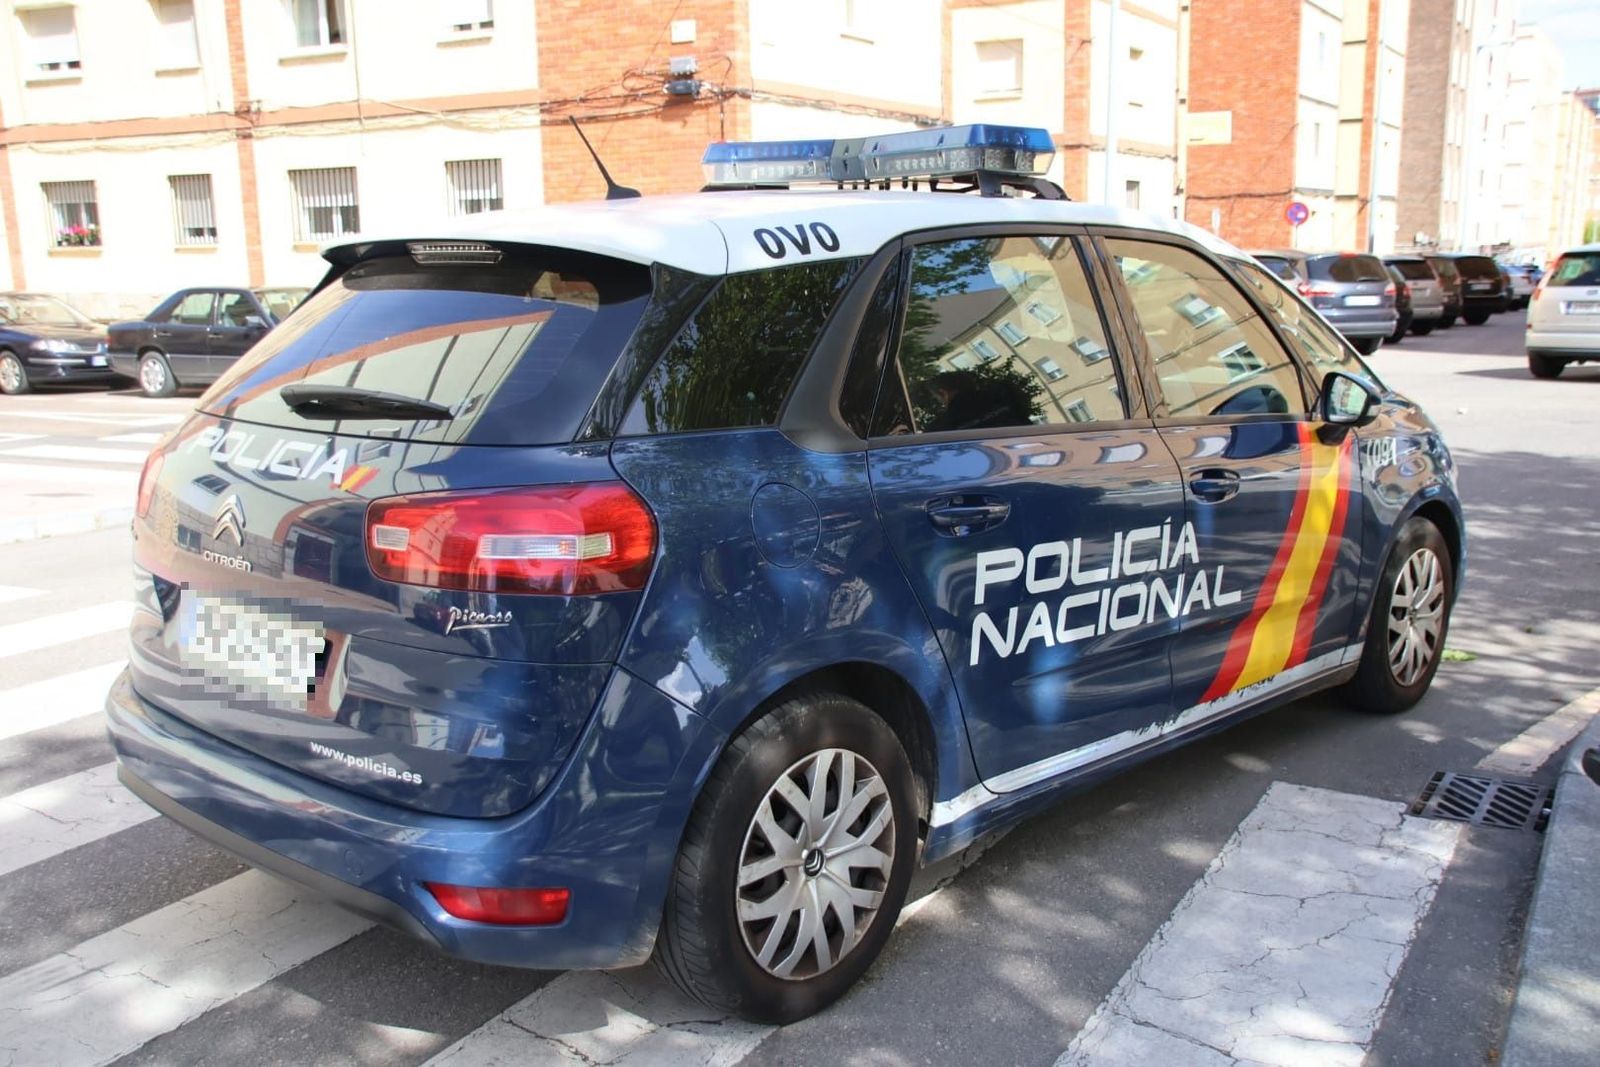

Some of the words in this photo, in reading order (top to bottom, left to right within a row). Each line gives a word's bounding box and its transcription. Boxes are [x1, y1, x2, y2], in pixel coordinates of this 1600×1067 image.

[974, 516, 1199, 605] POLICÍA
[446, 606, 513, 635] Picasso
[970, 565, 1242, 666] NACIONAL
[309, 741, 423, 784] www.policia.es
